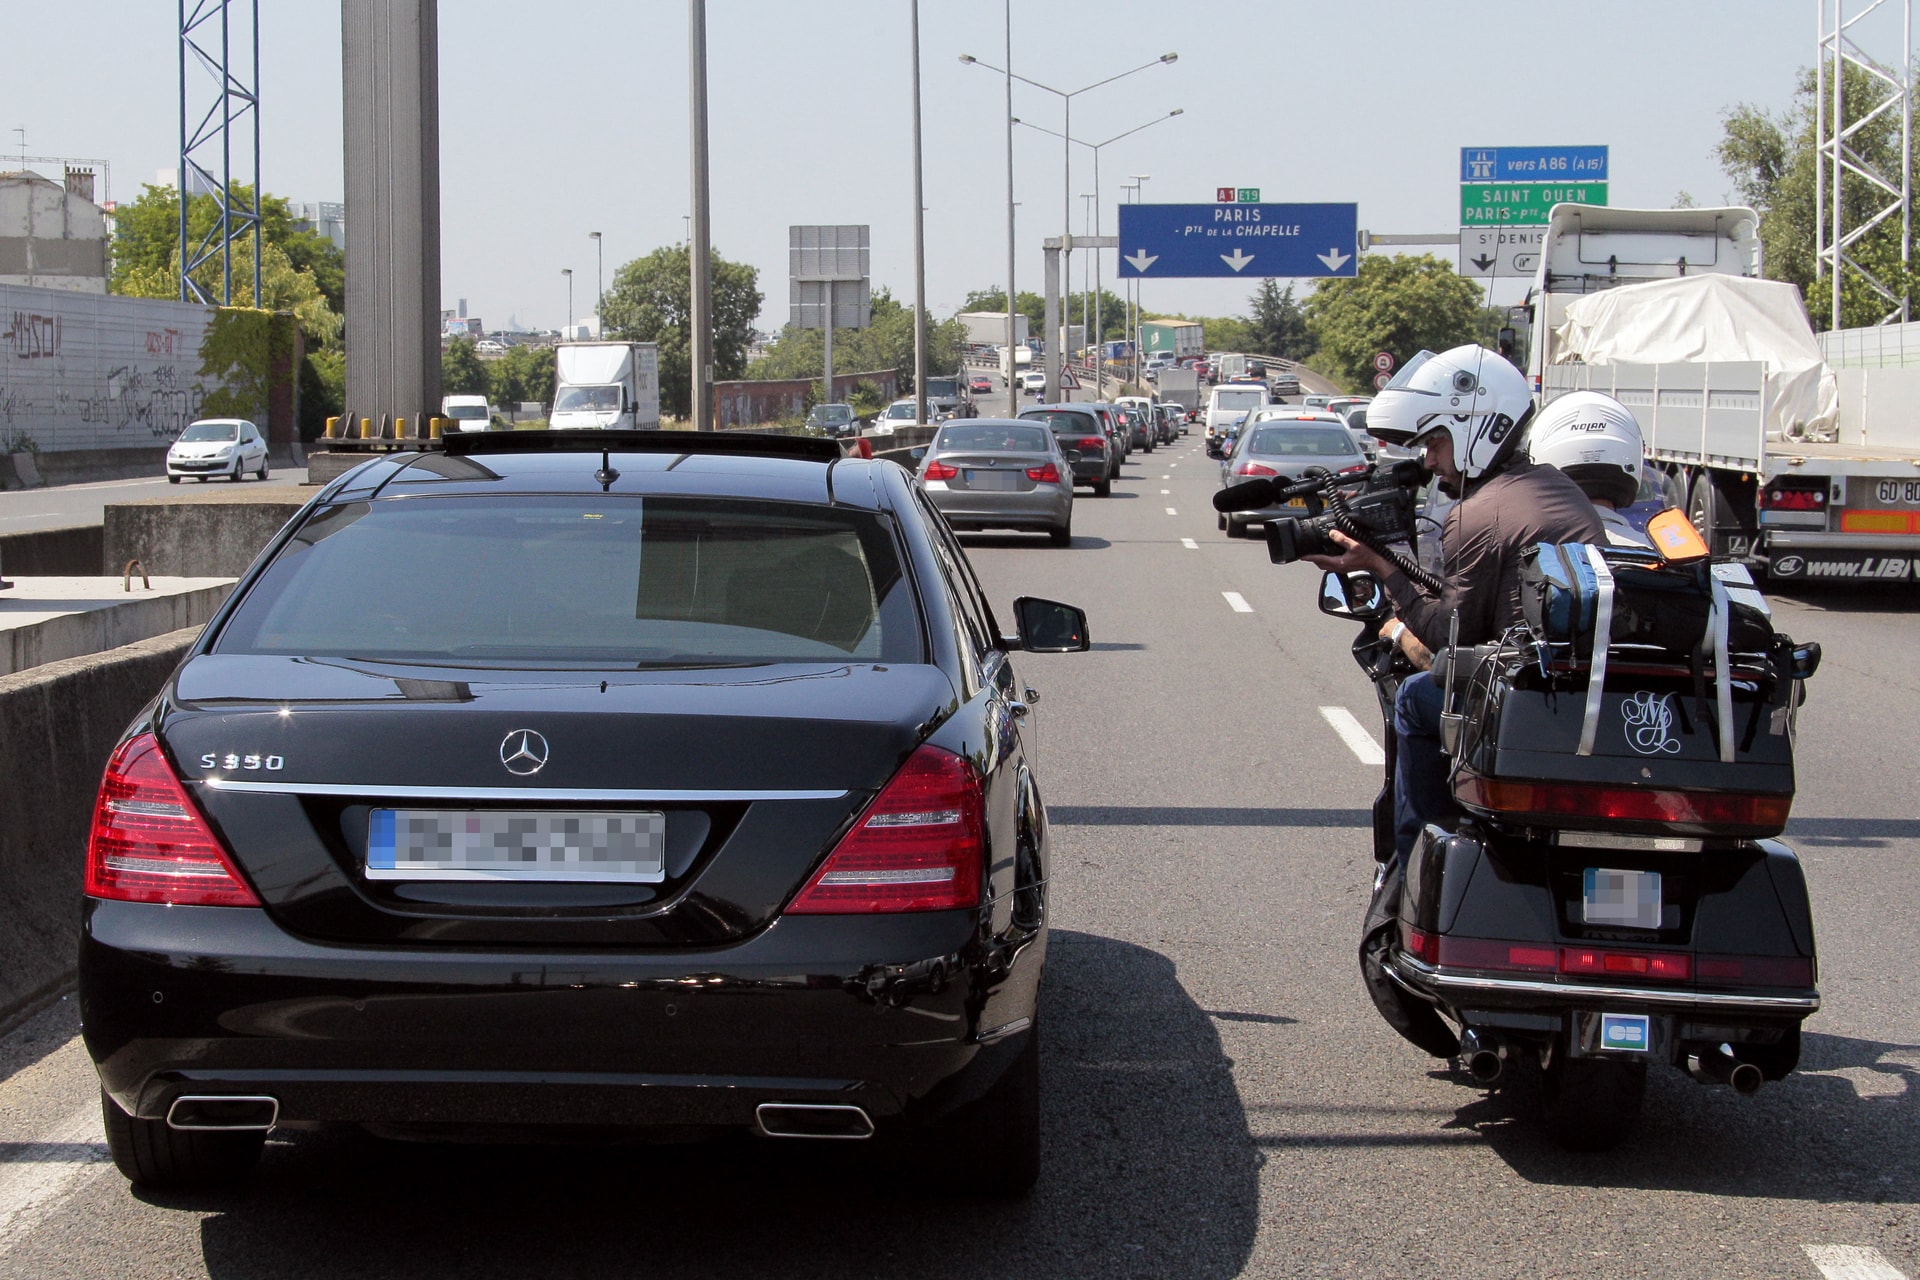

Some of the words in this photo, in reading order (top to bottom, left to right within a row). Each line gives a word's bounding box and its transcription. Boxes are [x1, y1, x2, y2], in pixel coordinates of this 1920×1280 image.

[1507, 160, 1535, 170] vers
[1239, 190, 1259, 200] E19
[1482, 190, 1530, 203] SAINT
[1543, 189, 1586, 202] OUEN
[1215, 209, 1261, 221] PARIS
[1236, 225, 1300, 236] CHAPELLE
[1499, 233, 1543, 244] DENIS
[1570, 422, 1607, 433] NOLAN
[1880, 481, 1898, 501] 60
[1905, 481, 1920, 501] 80
